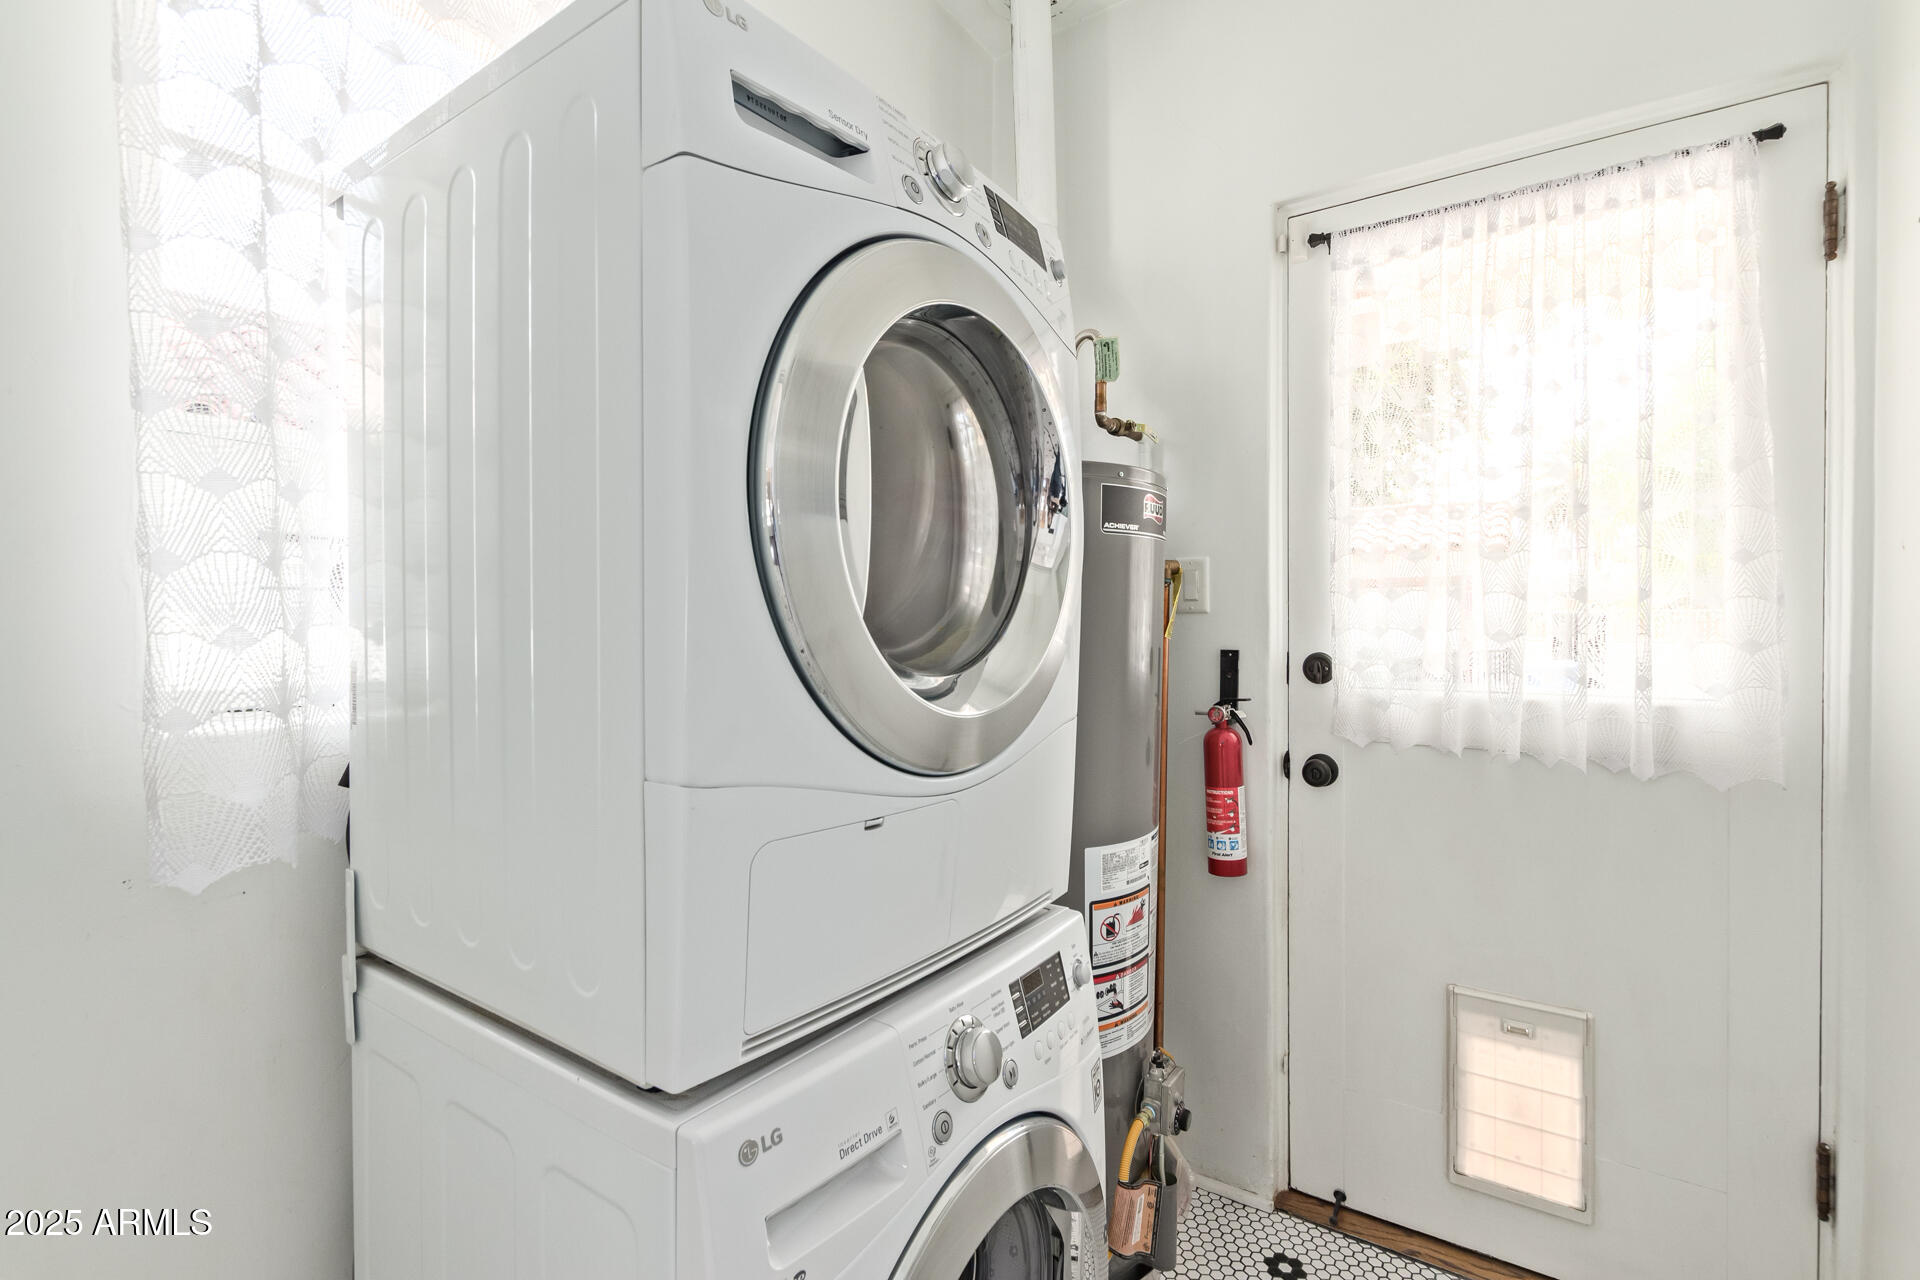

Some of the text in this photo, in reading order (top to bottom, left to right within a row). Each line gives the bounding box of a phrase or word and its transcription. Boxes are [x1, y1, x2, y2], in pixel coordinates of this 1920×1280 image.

[725, 6, 749, 32] LG
[828, 108, 853, 131] Sensor
[1103, 522, 1140, 531] ACHIEVER
[761, 1127, 783, 1153] LG
[839, 1125, 883, 1160] Direct Drive
